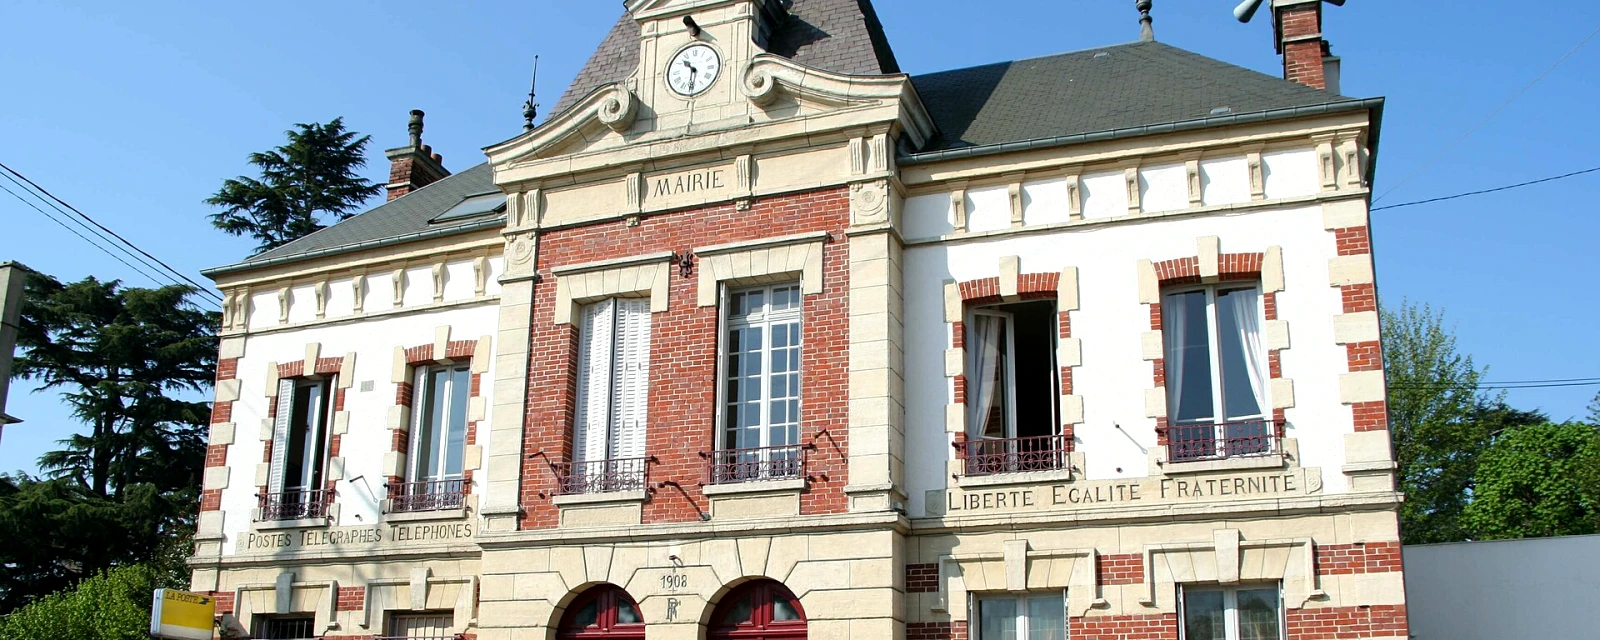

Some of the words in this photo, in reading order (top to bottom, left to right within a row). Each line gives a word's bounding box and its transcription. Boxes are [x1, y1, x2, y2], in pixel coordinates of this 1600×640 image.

[653, 169, 725, 198] MAIRIE
[248, 533, 292, 549] POSTES
[660, 574, 688, 589] 1908
[165, 591, 176, 601] LA
[176, 593, 199, 605] POSTE
